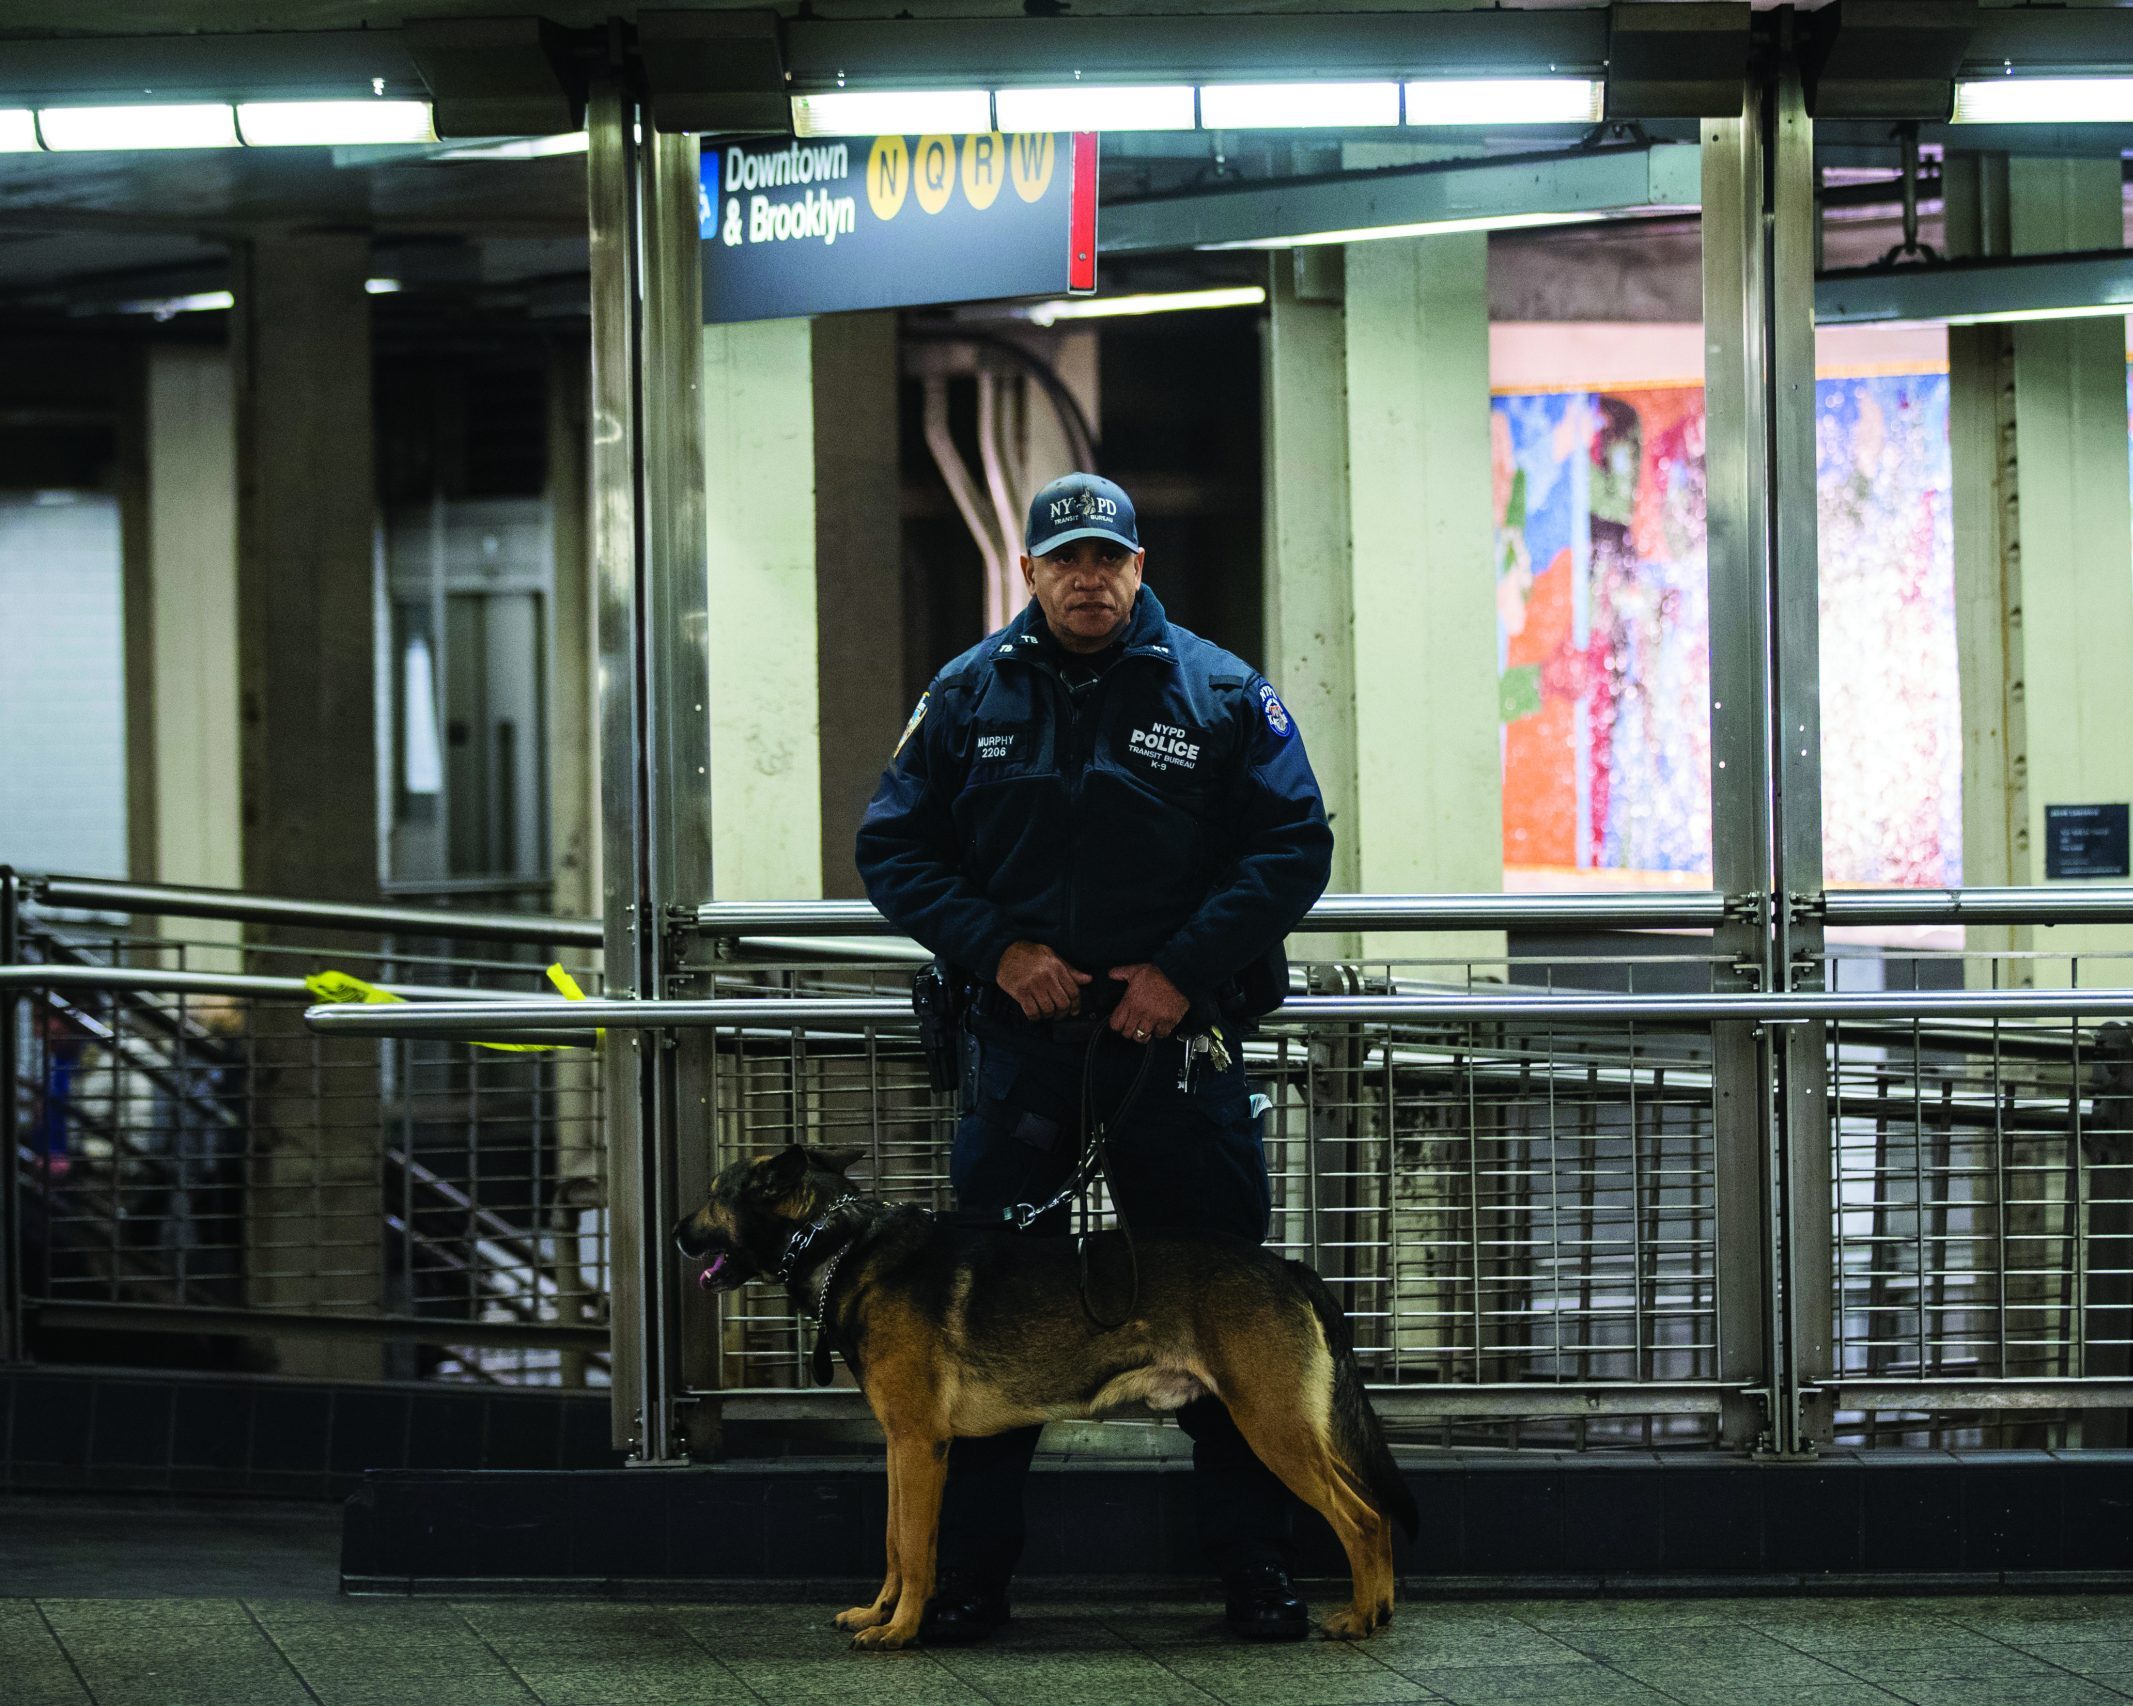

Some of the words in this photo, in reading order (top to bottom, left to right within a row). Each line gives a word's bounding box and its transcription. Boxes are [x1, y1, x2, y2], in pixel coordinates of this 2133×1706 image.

[725, 141, 848, 192] Downtown
[879, 148, 897, 198] N
[926, 141, 943, 191] Q
[975, 136, 993, 186] R
[1019, 133, 1047, 183] W
[723, 197, 743, 247] &
[749, 188, 855, 245] Brooklyn
[1054, 515, 1079, 526] TRANSIT
[977, 734, 1014, 748] MURPHY
[1152, 722, 1186, 739] NYPD
[981, 746, 1007, 758] 2206
[1130, 728, 1200, 760] POLICE
[1128, 744, 1162, 760] TRANSIT
[1164, 754, 1195, 770] BUREAU
[1151, 759, 1167, 771] K-9
